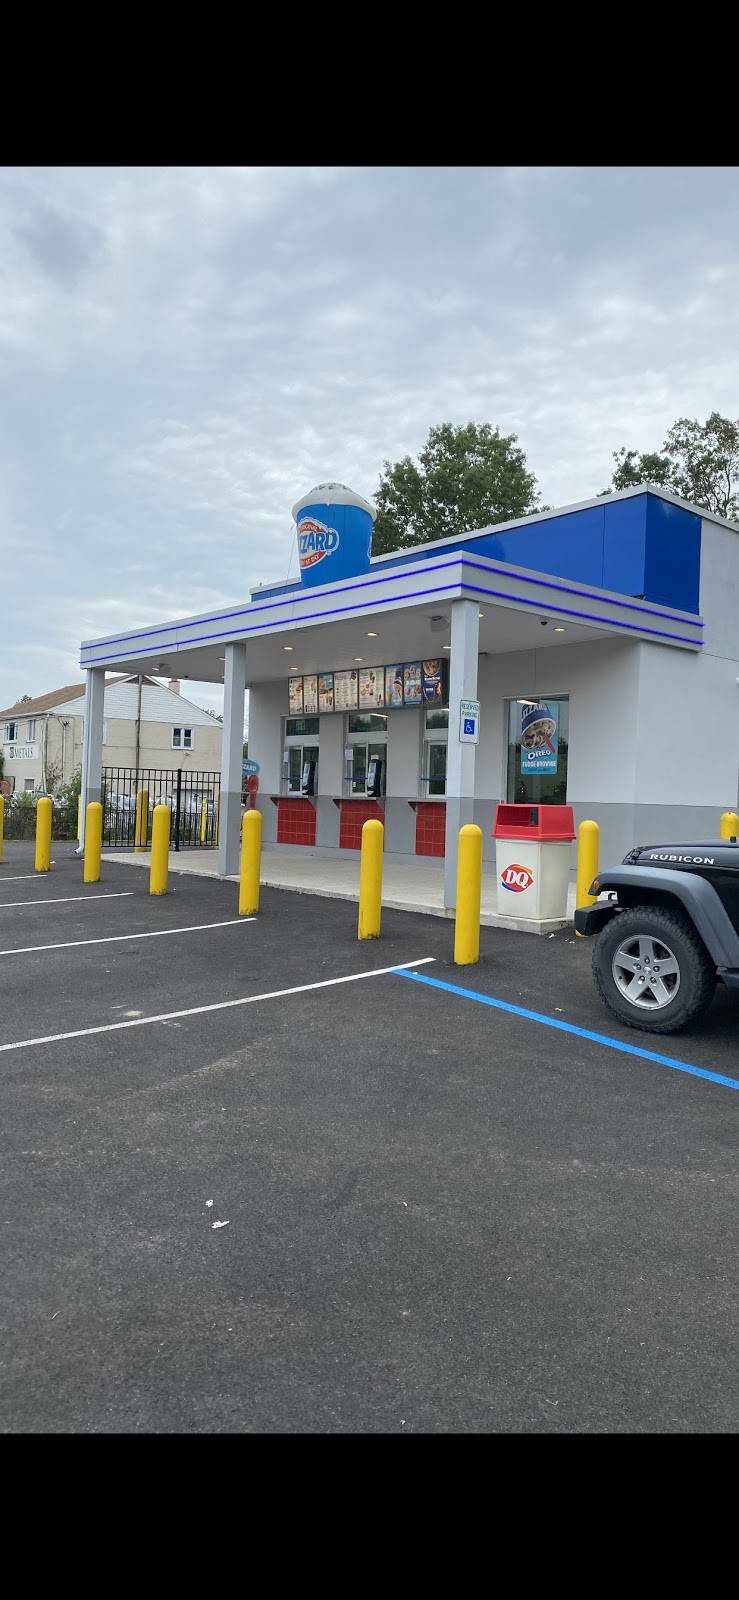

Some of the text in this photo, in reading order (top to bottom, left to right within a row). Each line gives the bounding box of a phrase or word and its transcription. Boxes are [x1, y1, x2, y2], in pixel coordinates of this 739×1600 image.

[527, 749, 551, 760] OREO
[536, 760, 557, 768] BROWNIE
[649, 854, 715, 865] RUBICON
[504, 869, 528, 889] DQ
